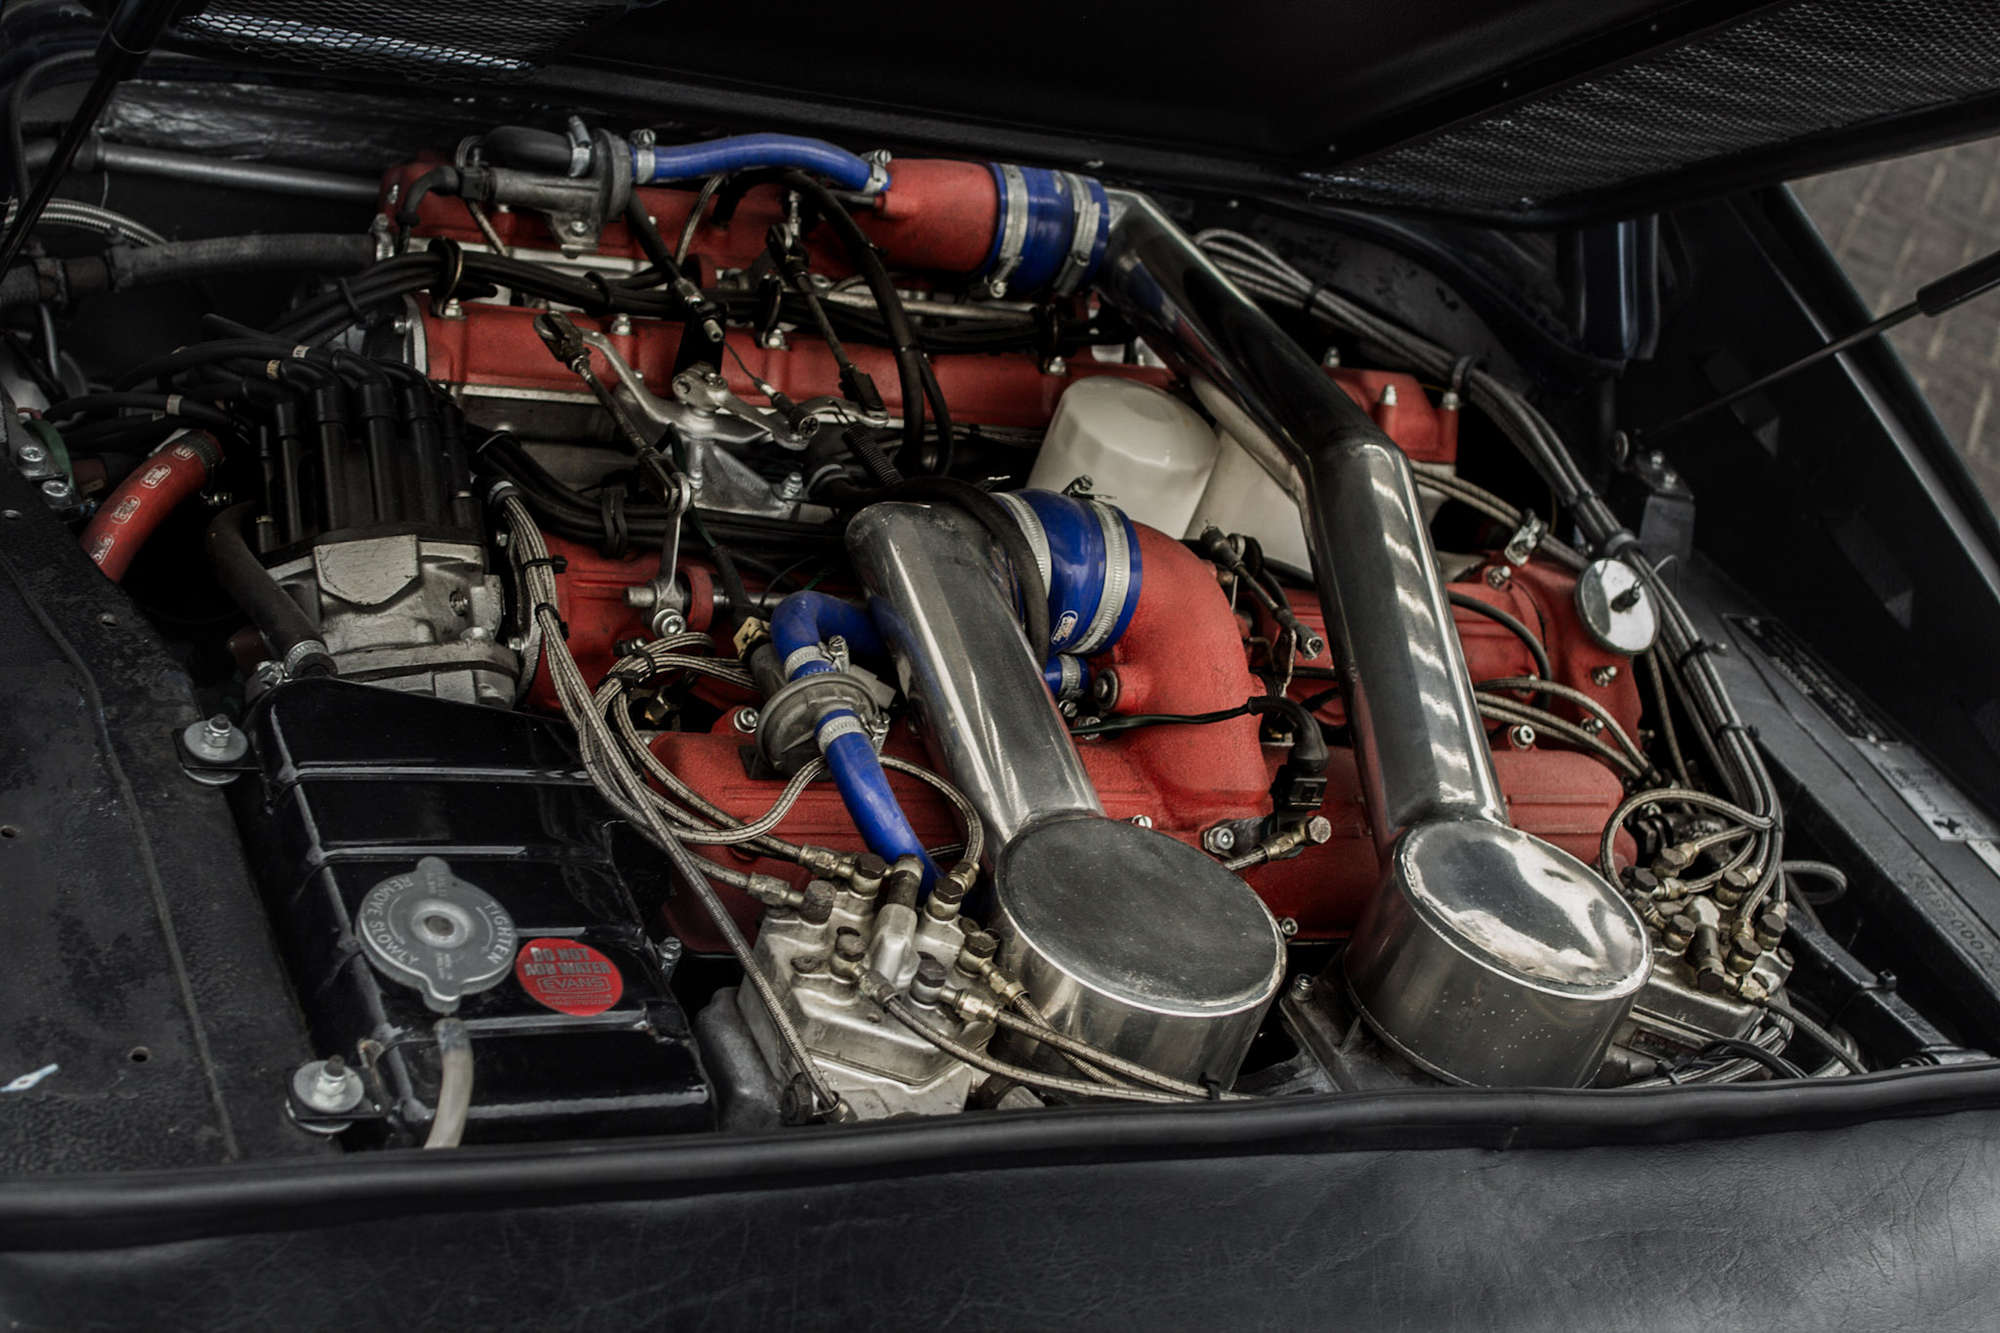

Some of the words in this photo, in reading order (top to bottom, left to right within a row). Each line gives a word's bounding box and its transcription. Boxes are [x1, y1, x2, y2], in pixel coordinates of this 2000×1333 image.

[367, 875, 414, 918] REMOVE
[367, 919, 420, 967] SLOWLY
[484, 901, 514, 965] TIGHTEN
[530, 946, 555, 962] DO
[558, 947, 590, 961] NOT
[558, 961, 612, 976] WATER
[541, 978, 607, 991] EVANS
